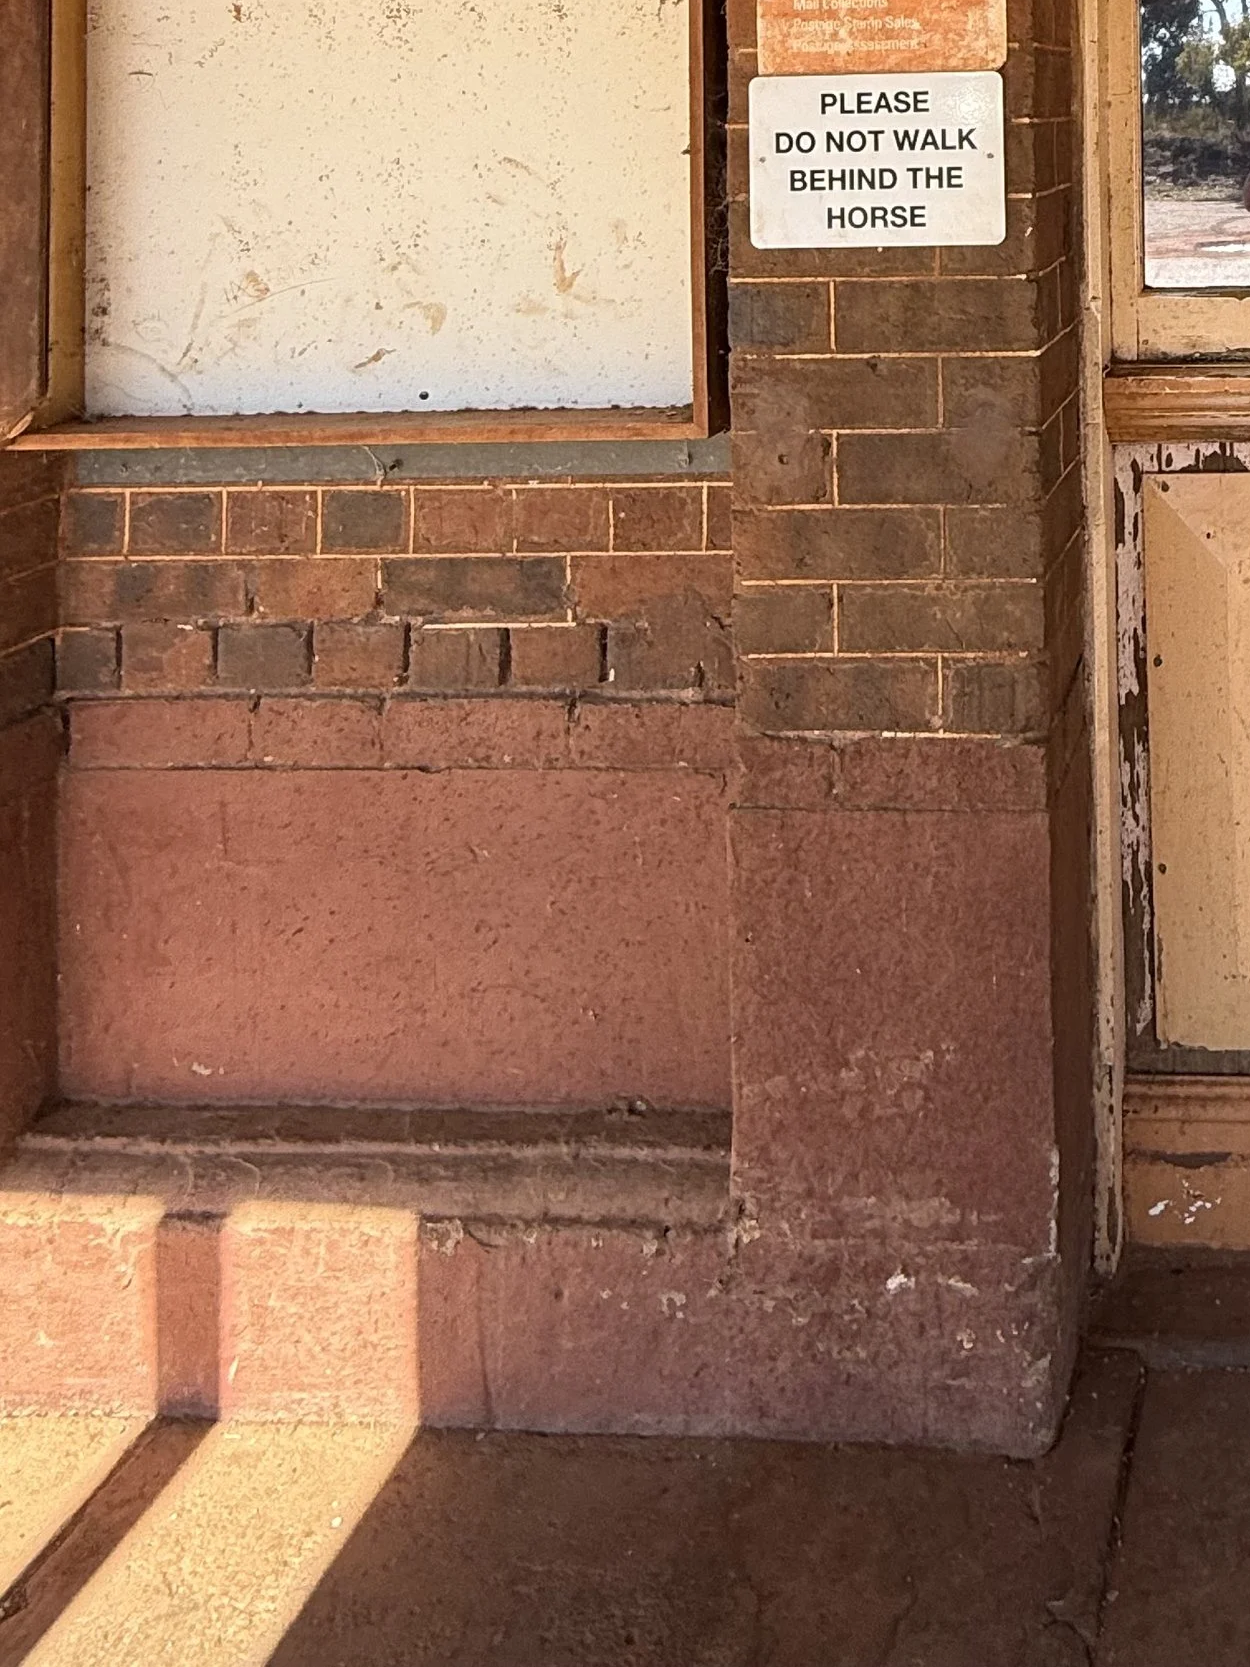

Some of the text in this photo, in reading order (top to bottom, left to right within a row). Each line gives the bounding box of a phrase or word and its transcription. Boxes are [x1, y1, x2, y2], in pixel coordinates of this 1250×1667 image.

[821, 91, 929, 115] PLEASE
[775, 128, 978, 154] DO NOT WALK
[789, 167, 964, 192] BEHIND THE
[826, 206, 927, 229] HORSE
